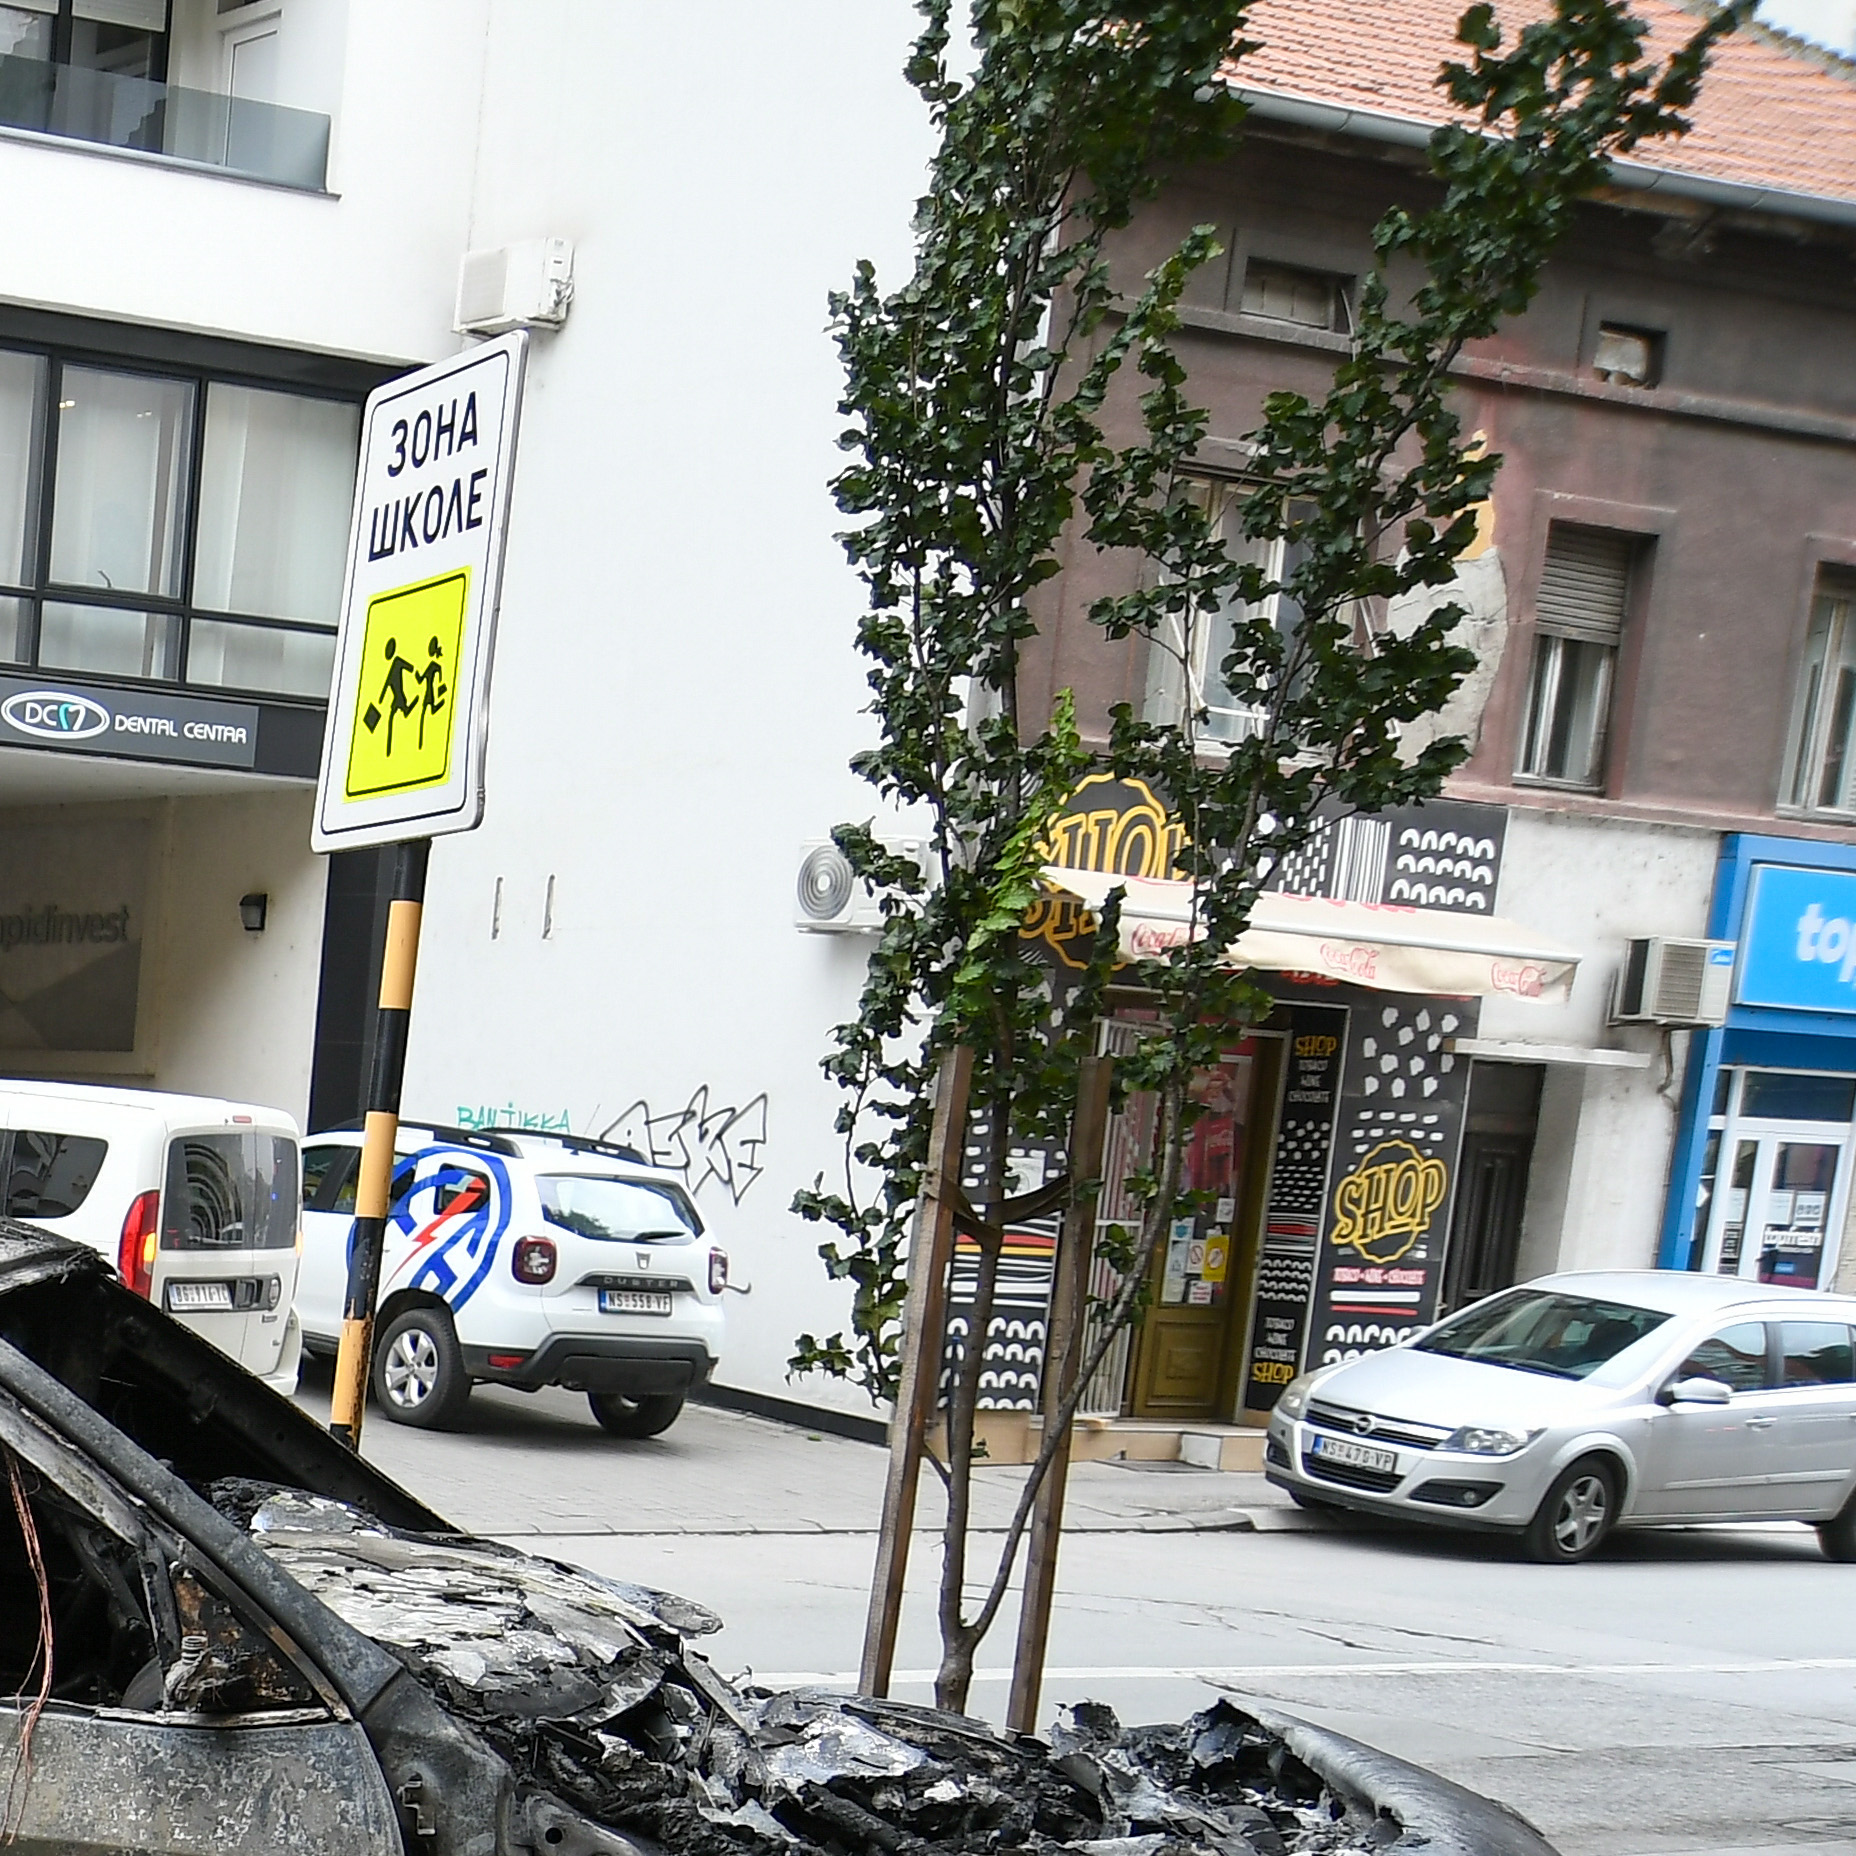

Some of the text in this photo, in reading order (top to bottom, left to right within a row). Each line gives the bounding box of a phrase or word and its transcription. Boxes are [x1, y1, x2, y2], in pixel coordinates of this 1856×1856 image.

[388, 391, 478, 477] ЗОНА
[368, 468, 488, 562] ШКОЛЕ
[114, 714, 178, 737] DENTAL
[183, 721, 248, 745] CENTAR
[1295, 1035, 1338, 1057] SHOP
[1330, 1158, 1448, 1245] SHOP
[603, 1277, 679, 1288] DUSTER
[608, 1292, 624, 1307] NS
[1252, 1362, 1294, 1385] SHOP
[1322, 1439, 1337, 1456] NS
